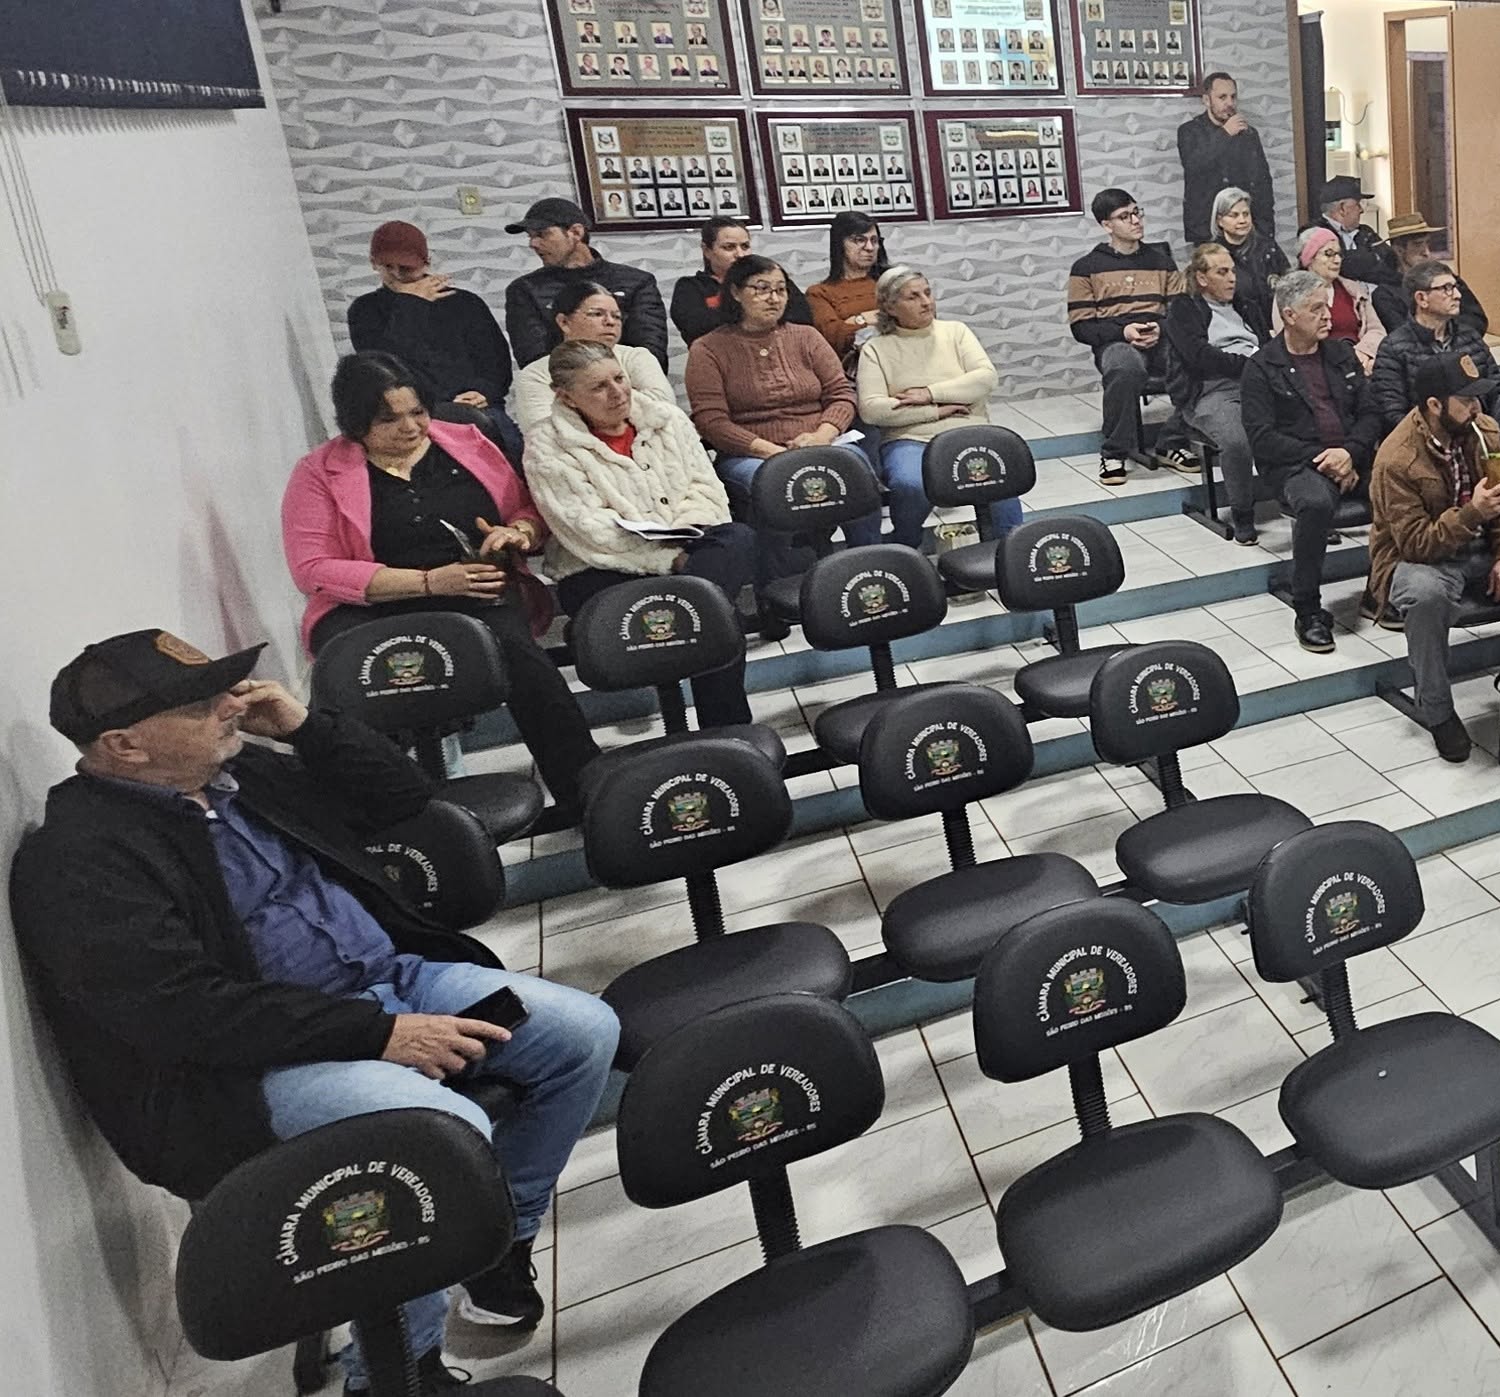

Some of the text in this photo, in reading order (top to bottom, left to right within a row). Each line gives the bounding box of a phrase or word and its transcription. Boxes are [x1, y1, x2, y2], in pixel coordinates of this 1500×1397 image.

[695, 773, 708, 782] DE
[387, 843, 402, 853] DE
[1344, 872, 1354, 881] DE
[1036, 946, 1137, 1022] CÂMARA MUNICIPAL DE VEREADORES
[696, 1064, 820, 1154] CÂMARA MUNICIPAL DE VEREADORES
[276, 1161, 435, 1265] CÂMARA MUNICIPAL DE VEREADORES
[294, 1270, 315, 1284] SÃO
[351, 1252, 369, 1263] DAS
[372, 1241, 408, 1256] MISSÕES
